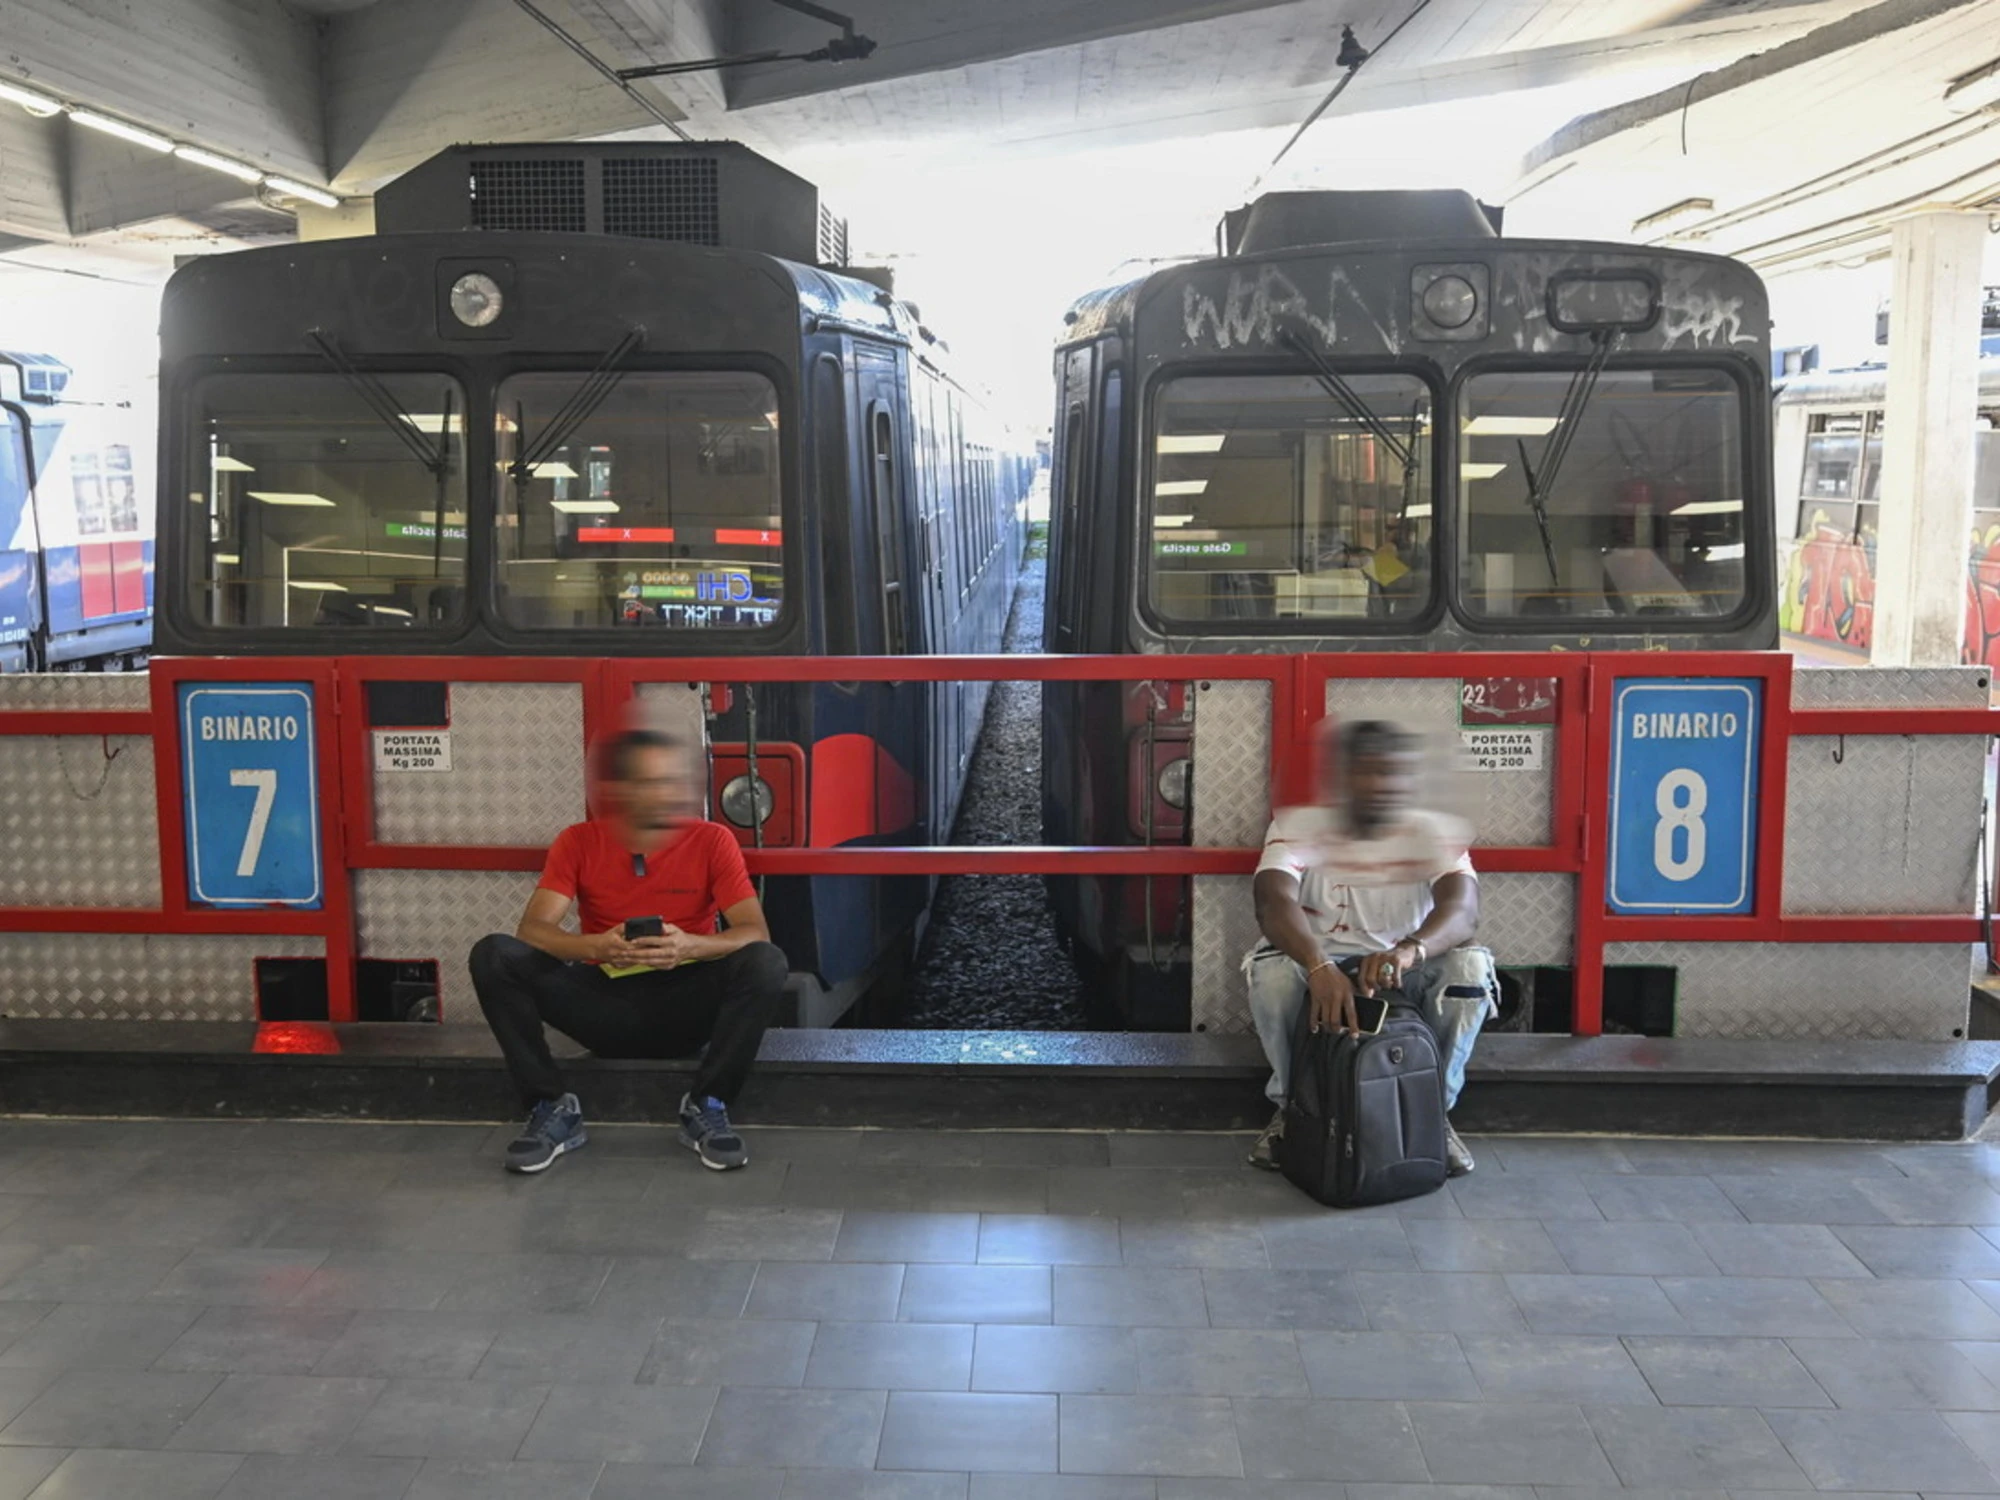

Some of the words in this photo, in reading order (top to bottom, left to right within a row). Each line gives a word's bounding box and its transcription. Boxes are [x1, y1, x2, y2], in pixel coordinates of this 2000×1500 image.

[1463, 684, 1486, 704] 22
[201, 716, 298, 741] BINARIO
[1632, 712, 1738, 739] BINARIO
[383, 736, 441, 745] PORTATA
[1471, 735, 1532, 744] PORTATA
[383, 747, 442, 756] MASSIMA
[1471, 746, 1533, 755] MASSIMA
[392, 758, 409, 768] Kg
[412, 758, 435, 767] 200
[1478, 758, 1497, 769] Kg
[1500, 758, 1525, 767] 200
[230, 769, 278, 877] 7
[1654, 768, 1708, 881] 8
